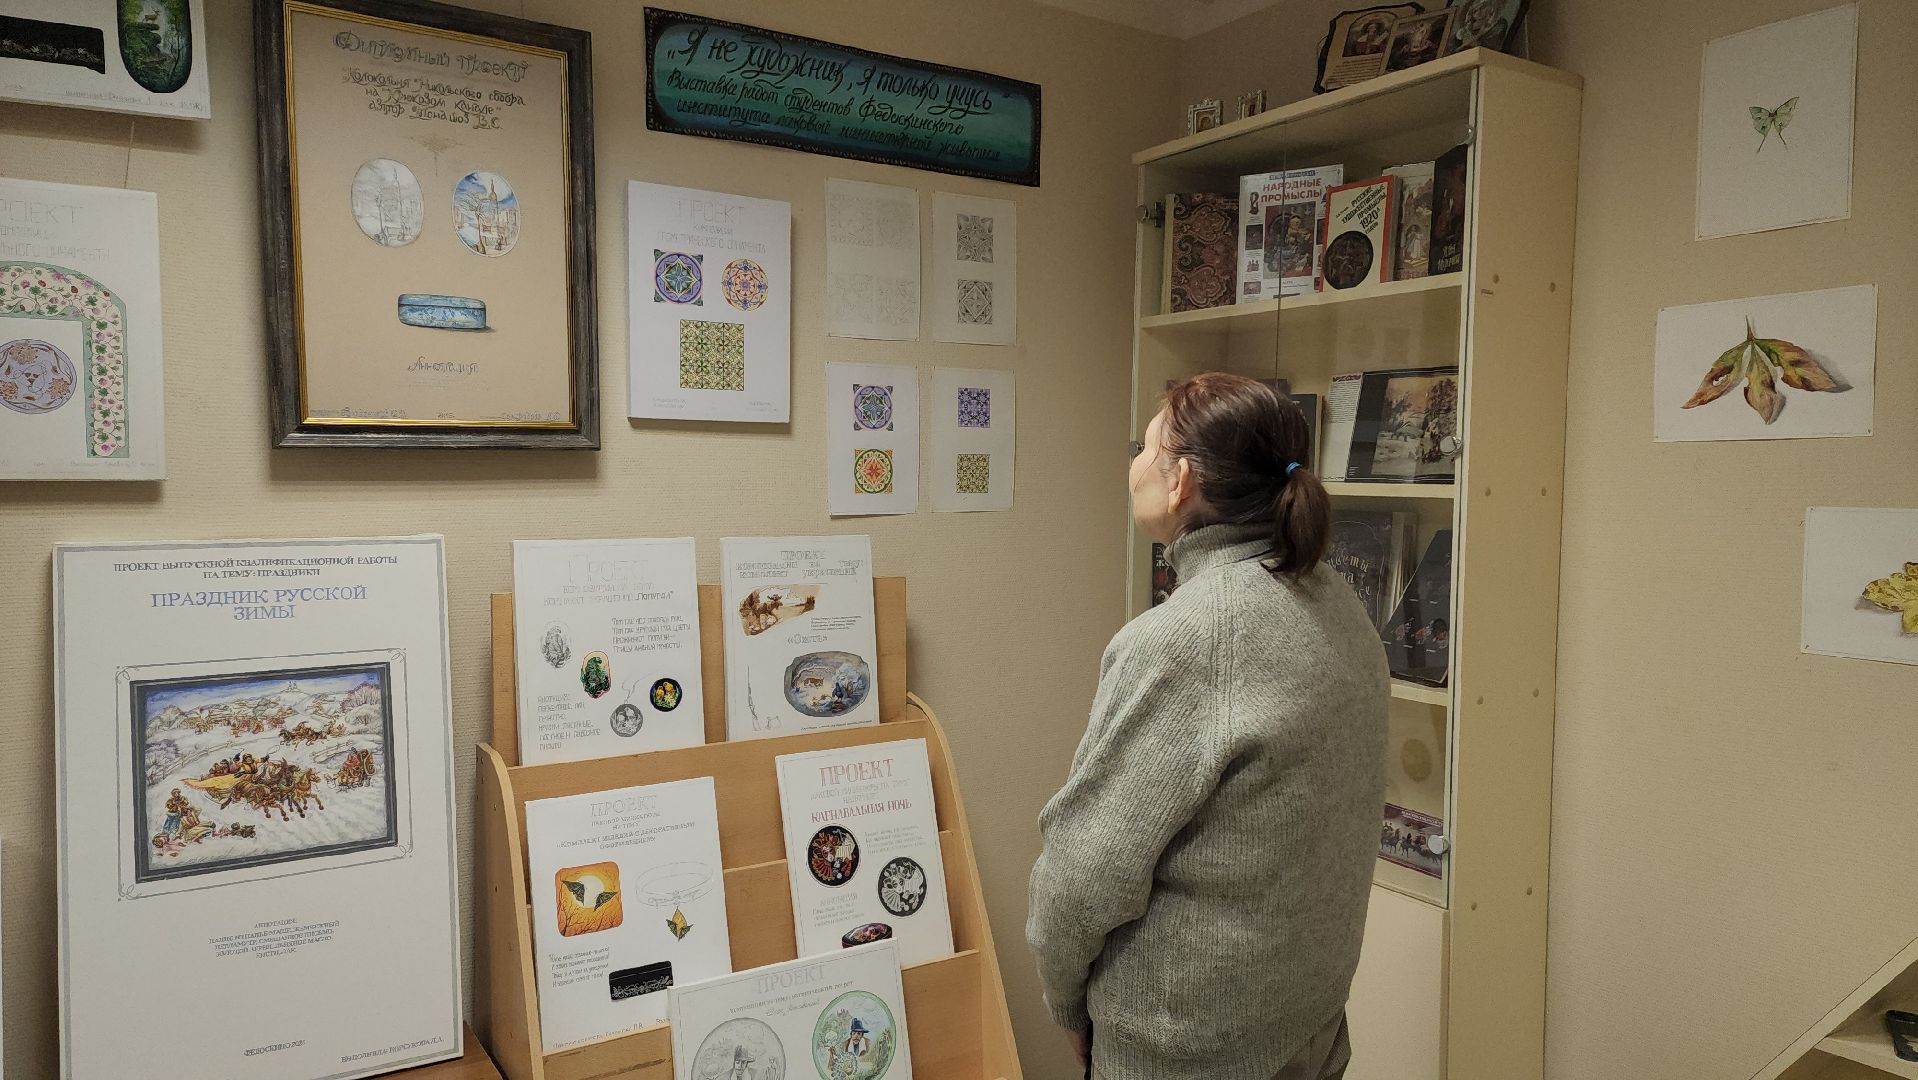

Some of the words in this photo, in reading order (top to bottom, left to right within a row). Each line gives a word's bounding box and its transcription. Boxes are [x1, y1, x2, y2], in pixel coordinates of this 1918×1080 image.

[709, 38, 736, 63] не
[876, 73, 940, 110] только
[667, 68, 737, 105] Выставка
[736, 79, 782, 106] работ
[783, 88, 852, 117] студентов
[858, 98, 964, 136] Федоскинского
[676, 98, 771, 129] института
[1261, 190, 1322, 203] ПРОМЫСЛЫ
[1263, 178, 1322, 192] НАРОДНЫЕ
[1342, 184, 1386, 224] ХУДОЖЕСТВЕННЫЕ
[1357, 192, 1387, 220] ПРОМЫСЛЫ
[113, 562, 159, 572] ПРОЕКТ
[162, 557, 235, 571] ВЫПУСКНОЙ
[235, 555, 355, 569] КВАЛИФИКАЦИОННОЙ
[357, 555, 398, 566] РАБОТЫ
[151, 588, 269, 608] ПРАЗДНИК
[274, 584, 368, 604] РУССКОЙ
[233, 605, 296, 622] ЗИМЫ
[819, 758, 894, 787] ПРОЕКТ
[811, 803, 885, 823] КАРНАВАЛЬНАЯ
[887, 798, 912, 812] НОЧЬ
[757, 965, 827, 994] ПРОЕКТ
